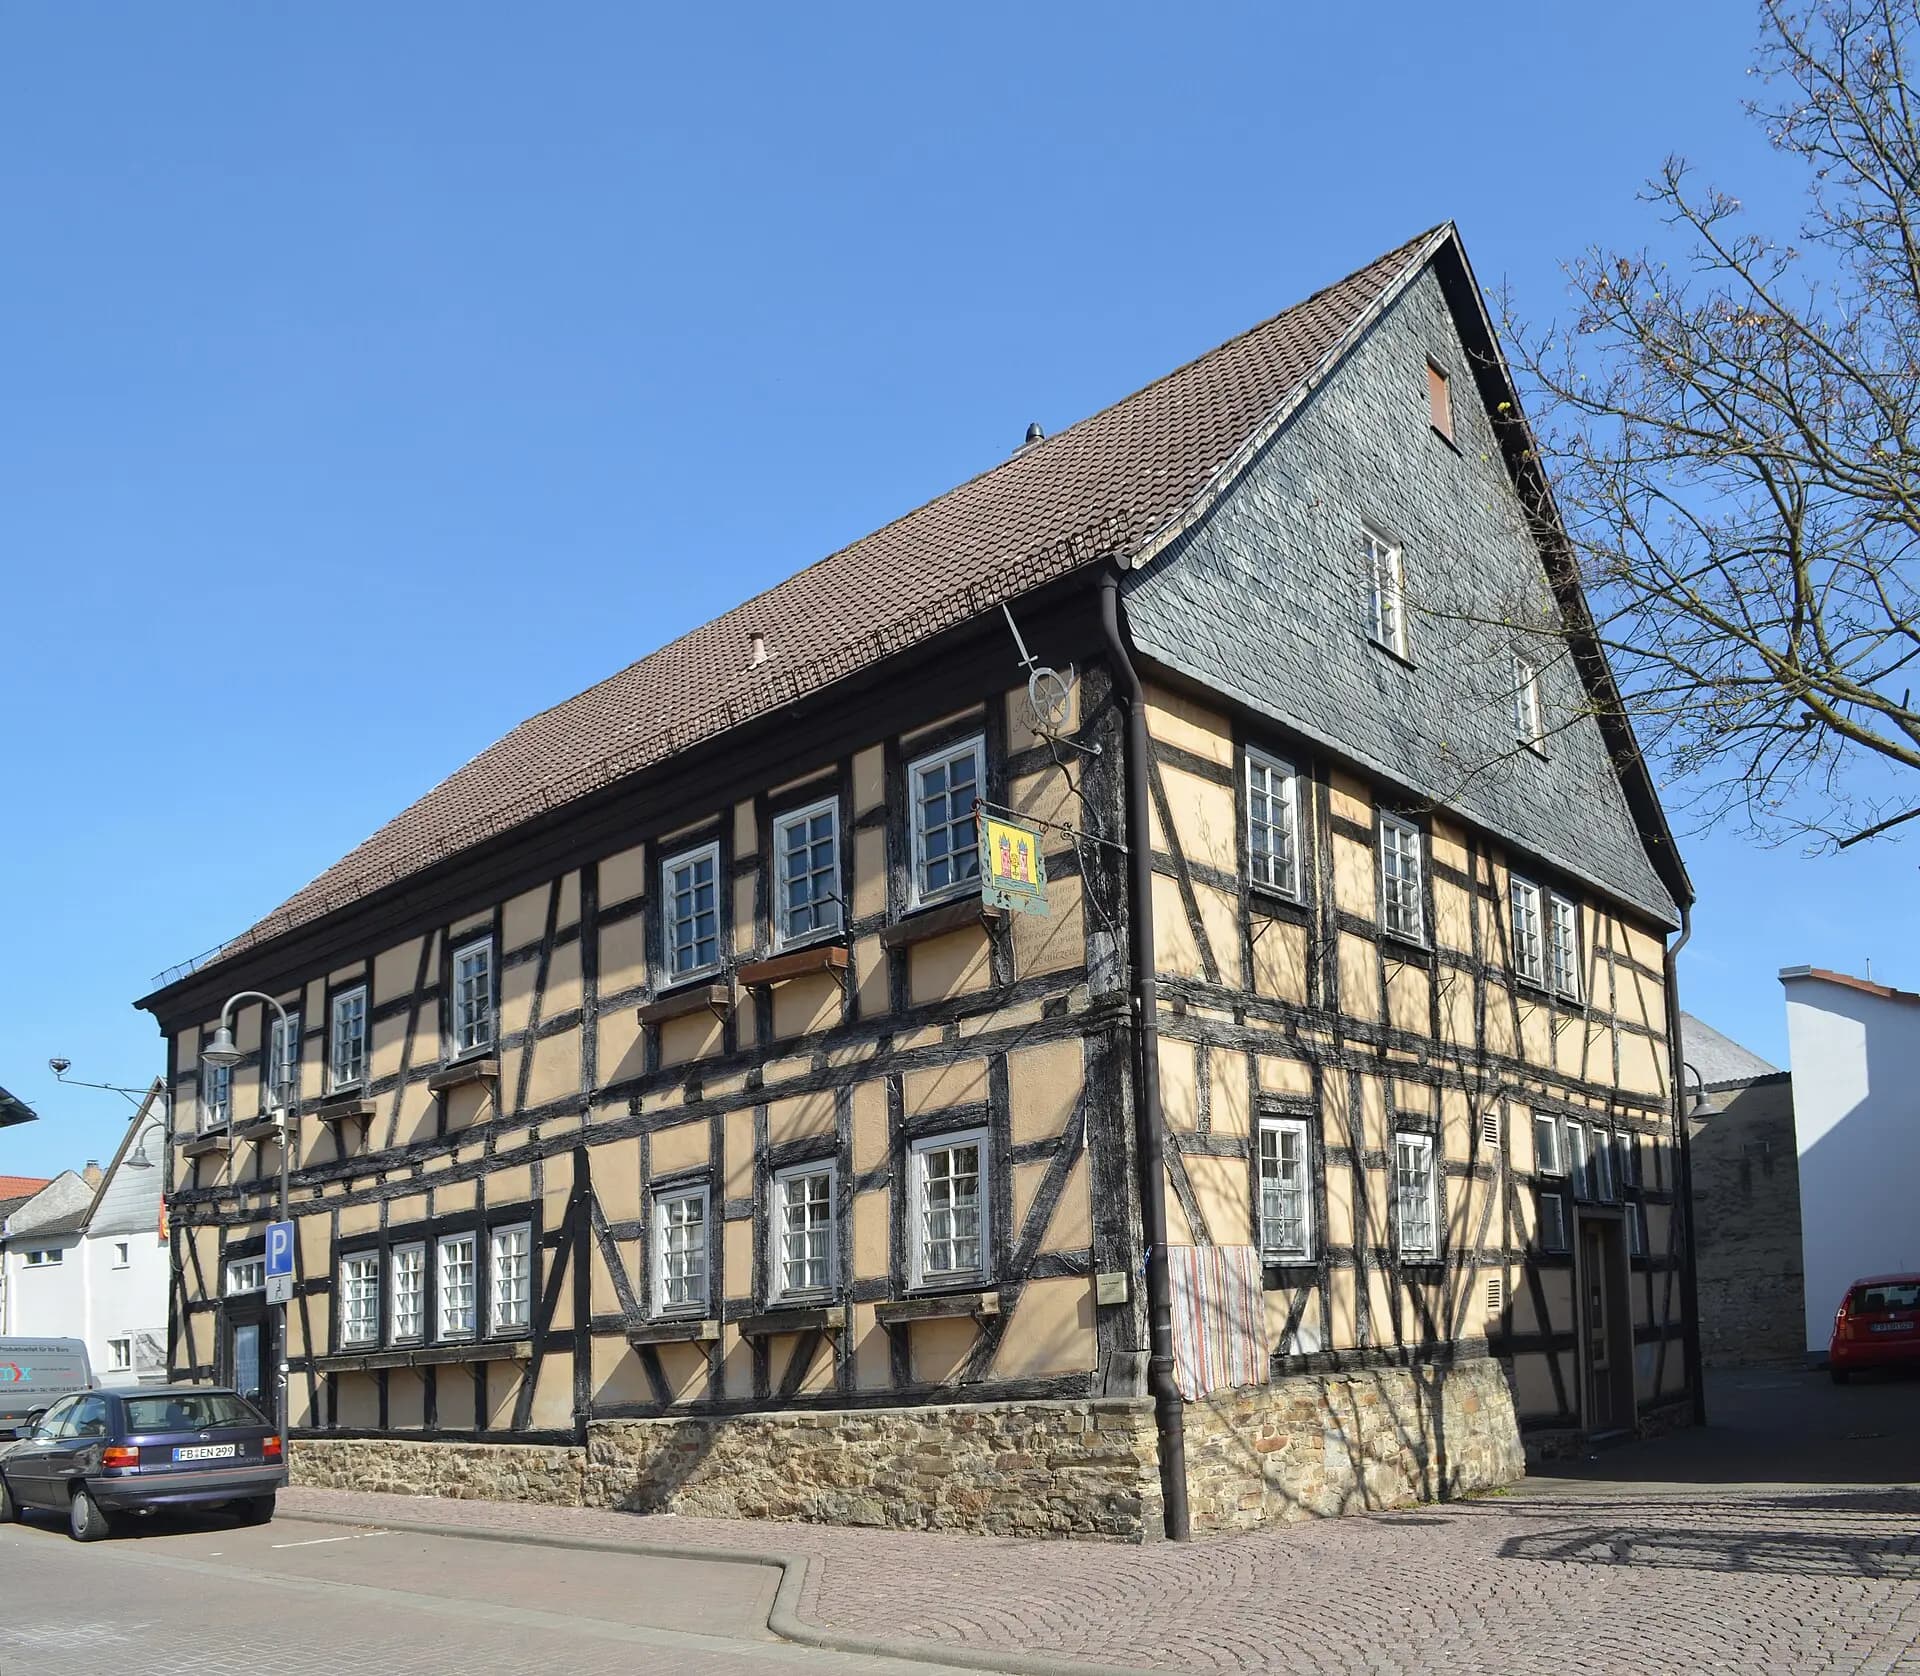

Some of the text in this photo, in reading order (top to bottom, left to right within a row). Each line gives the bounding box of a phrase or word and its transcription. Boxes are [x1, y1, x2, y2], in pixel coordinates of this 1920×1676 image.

[272, 1230, 287, 1269] P
[180, 1449, 193, 1459] FB
[200, 1449, 213, 1458] EN
